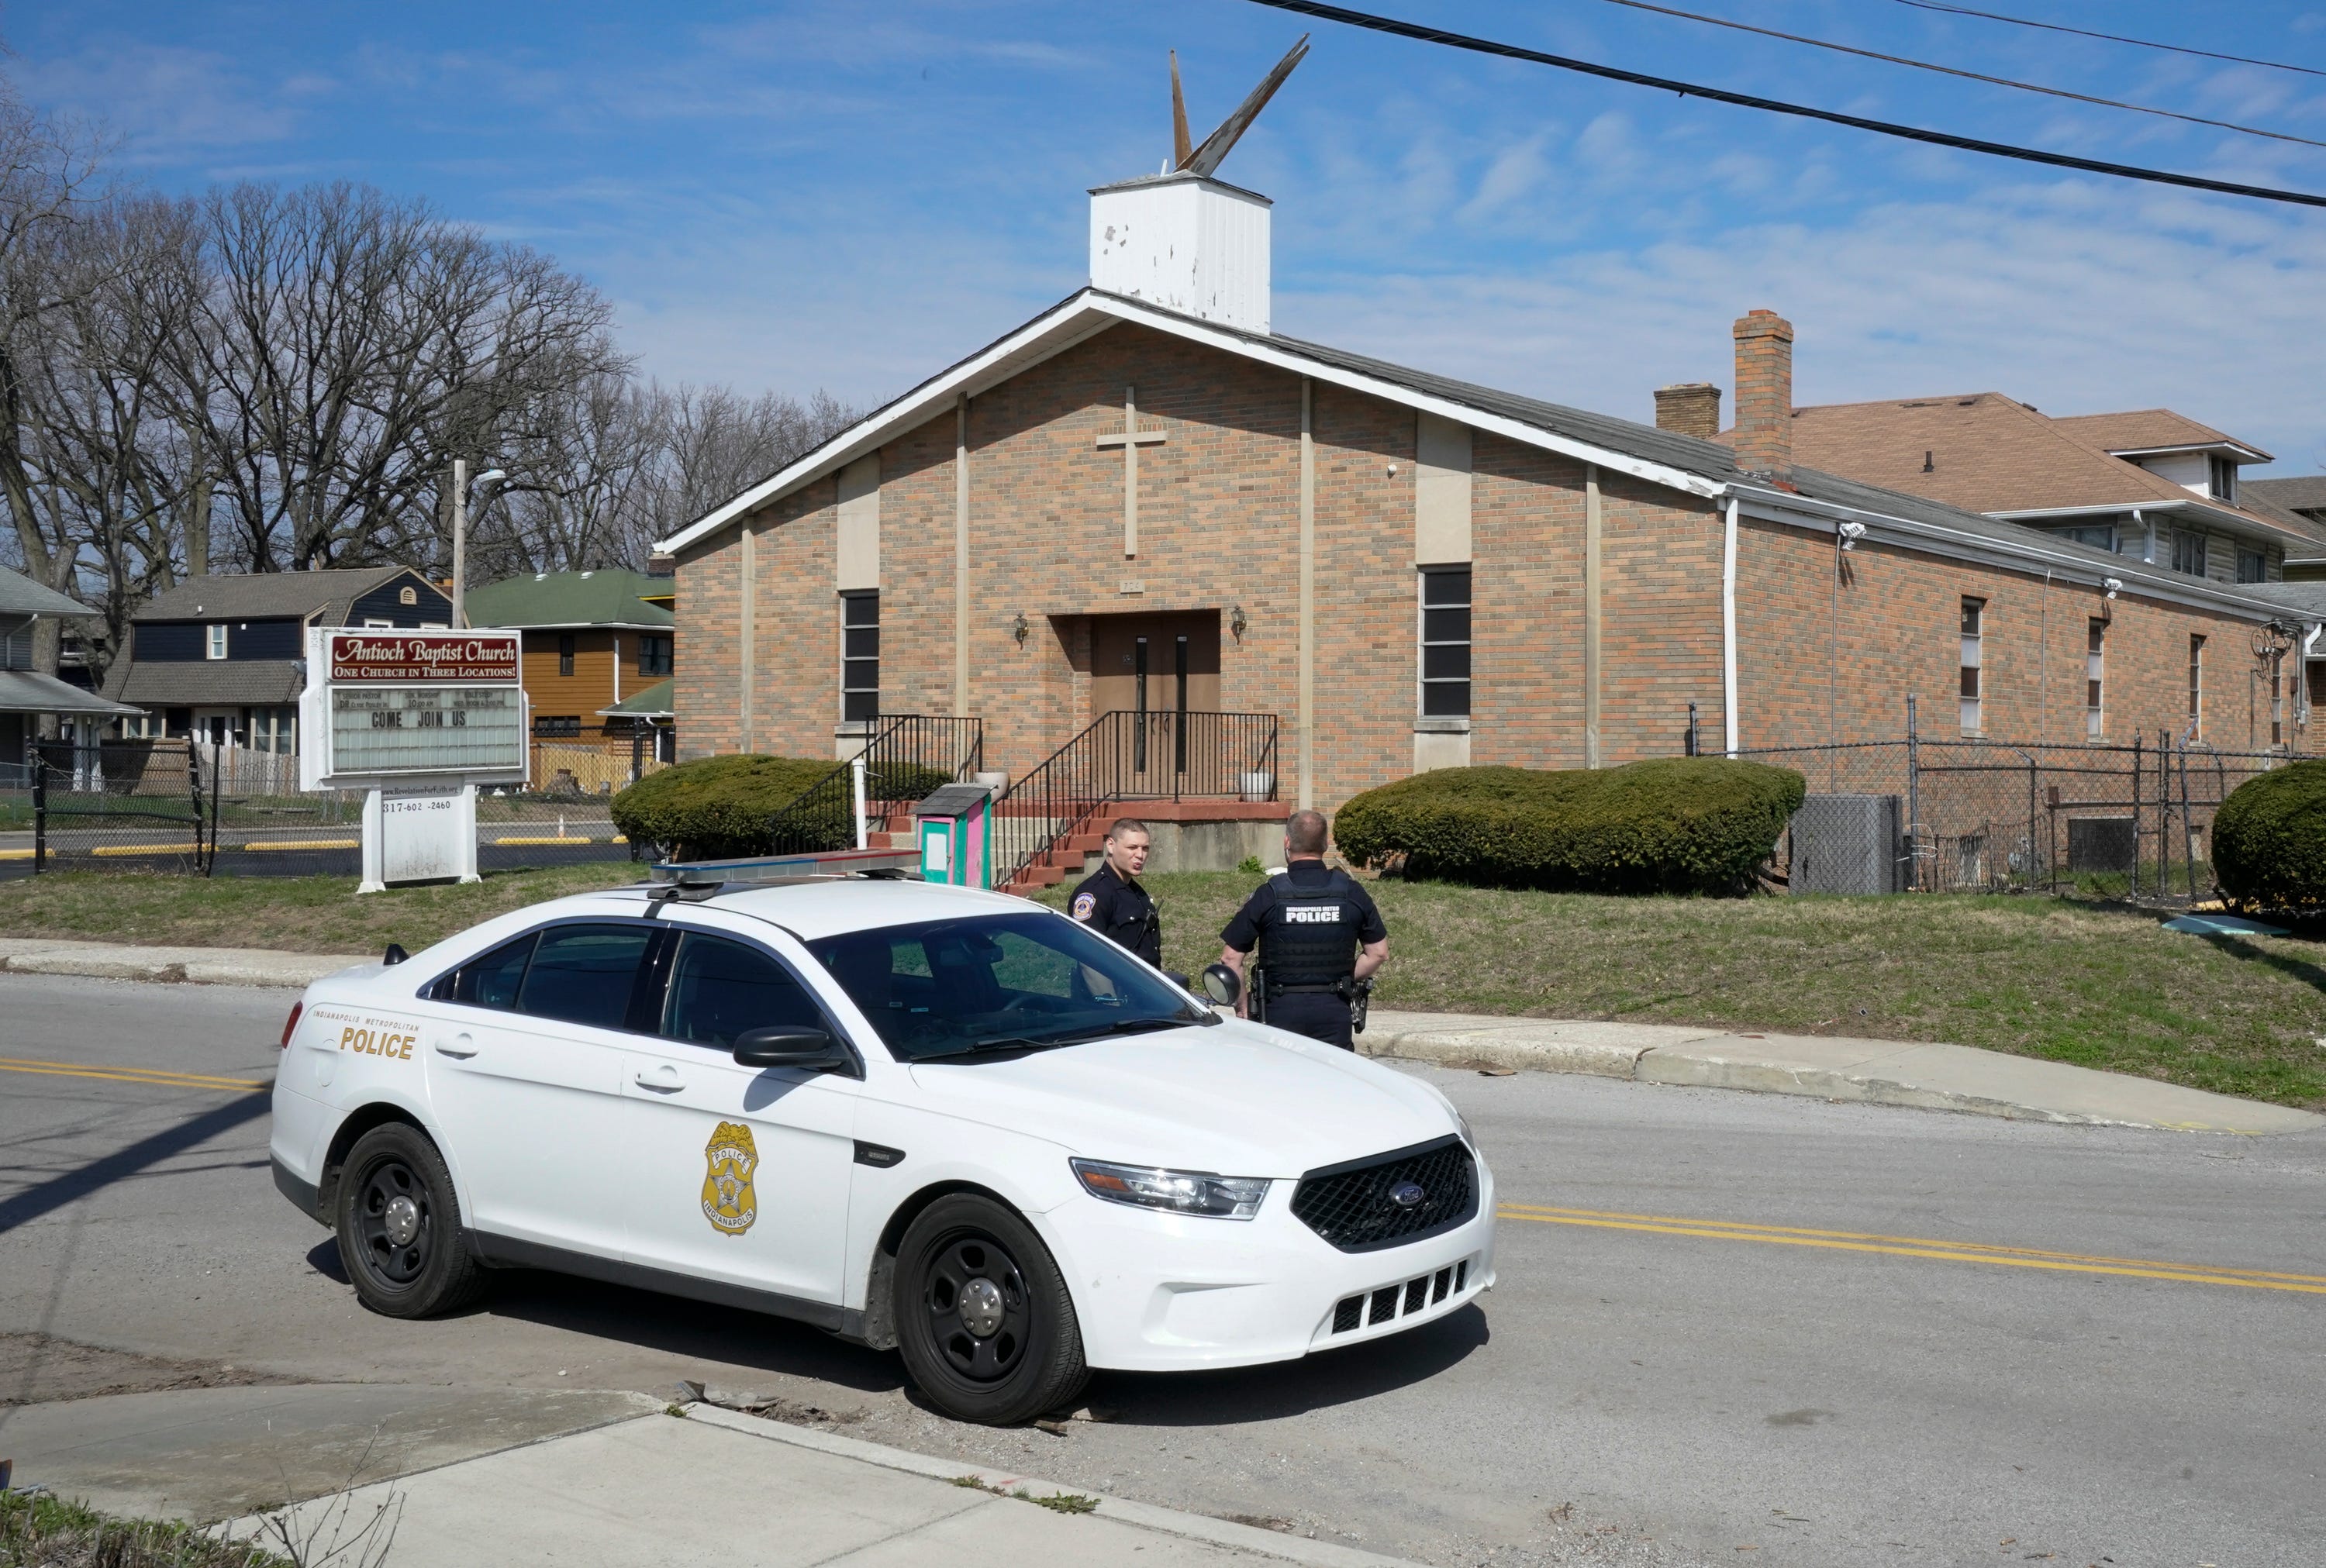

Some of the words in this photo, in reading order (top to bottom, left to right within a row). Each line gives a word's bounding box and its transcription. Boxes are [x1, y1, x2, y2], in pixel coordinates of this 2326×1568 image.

[335, 639, 405, 662] Antioch
[409, 640, 463, 667] Baptist
[465, 640, 516, 661] Church
[334, 667, 358, 677] ONE
[361, 667, 405, 677] CHURCH
[408, 668, 419, 677] IN
[422, 667, 456, 677] THREE
[458, 667, 516, 677] LOCATIONS!
[372, 712, 402, 727] COME
[418, 711, 443, 727] JOIN
[452, 711, 466, 726] US
[1286, 912, 1341, 922] POLICE
[313, 1010, 360, 1023] INDIANAPOLIS
[365, 1018, 419, 1032] METROPOLITAN
[340, 1027, 416, 1060] POLICE
[715, 1149, 747, 1167] POLICE
[705, 1203, 753, 1227] INDIANAPOLIS
